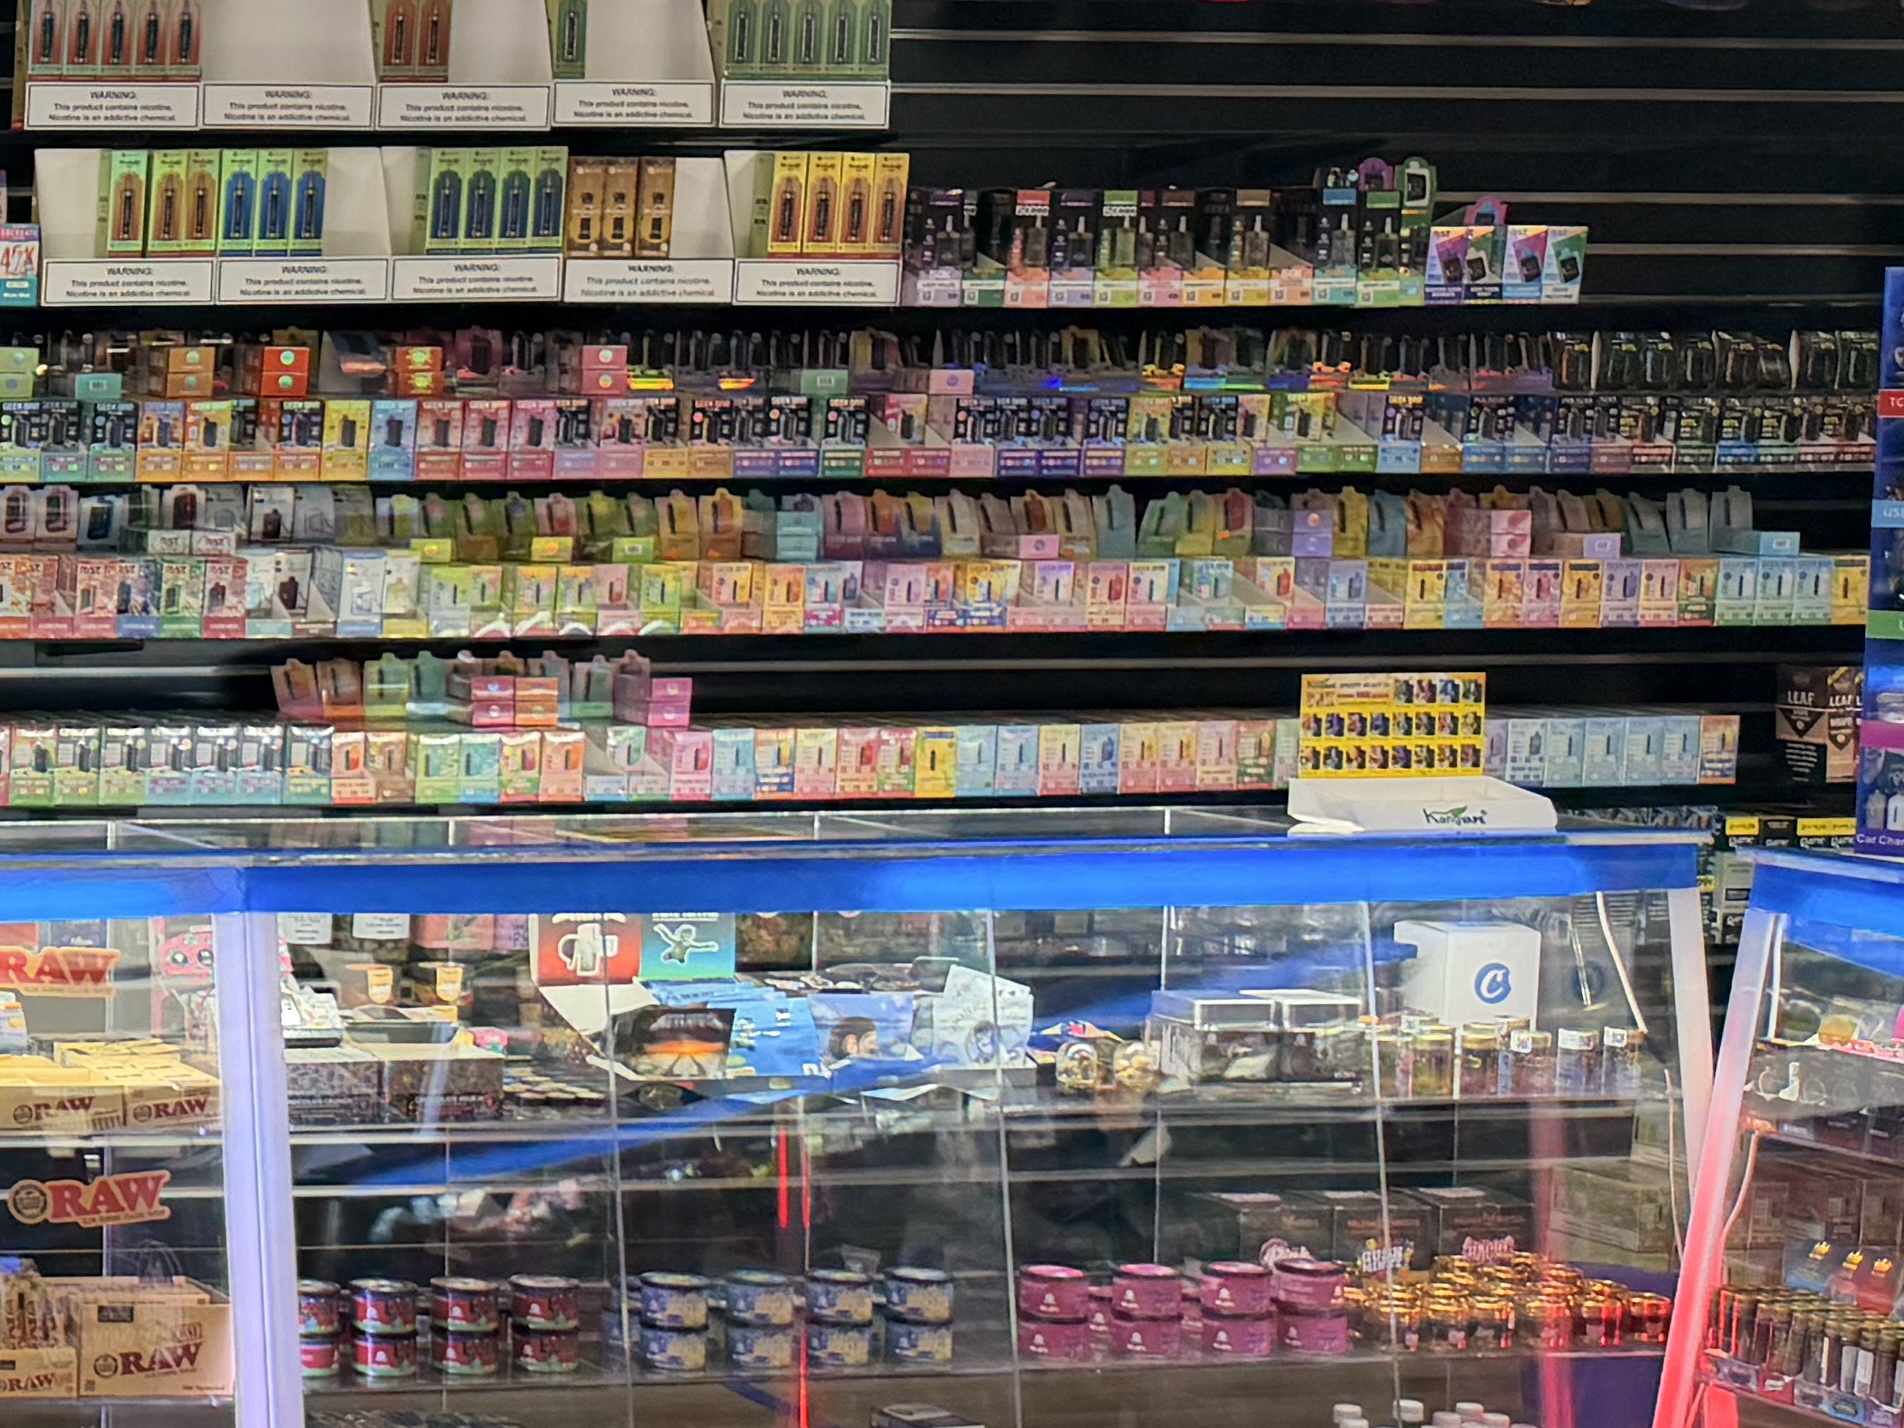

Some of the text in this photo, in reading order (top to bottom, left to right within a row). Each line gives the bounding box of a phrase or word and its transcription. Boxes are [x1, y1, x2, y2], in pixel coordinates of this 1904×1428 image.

[54, 103, 172, 112] This product contains nicotine.
[48, 114, 80, 123] Nicotine
[104, 114, 138, 123] addictive
[139, 114, 176, 123] chemical.
[1787, 691, 1815, 706] LEAF
[1830, 695, 1852, 707] LEAF
[49, 1176, 165, 1217] RAW
